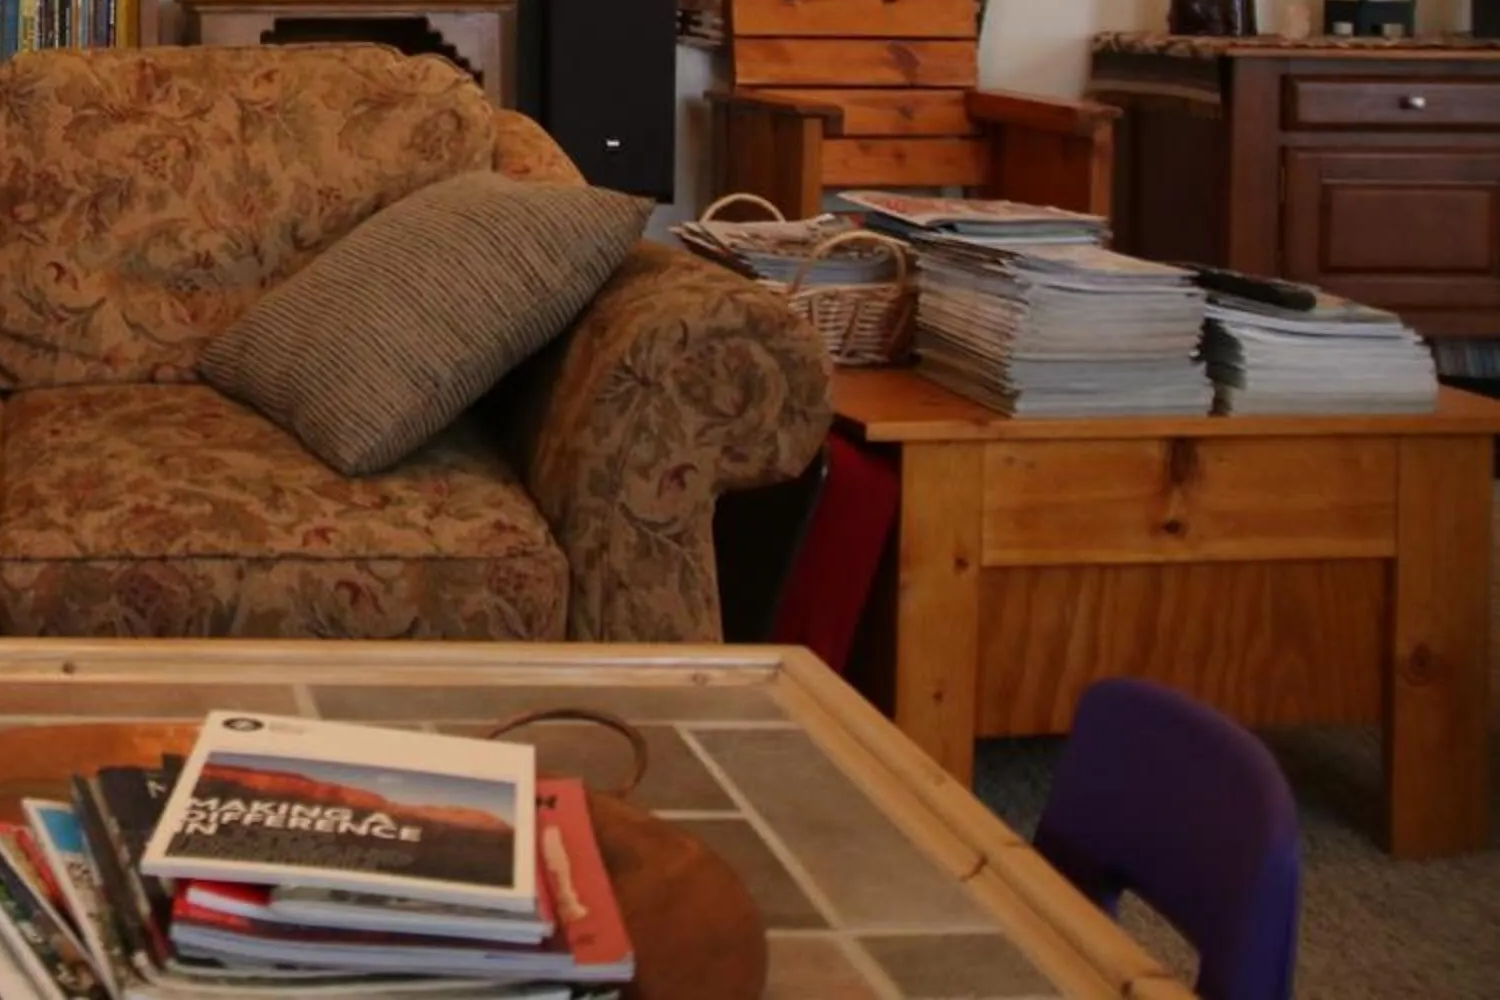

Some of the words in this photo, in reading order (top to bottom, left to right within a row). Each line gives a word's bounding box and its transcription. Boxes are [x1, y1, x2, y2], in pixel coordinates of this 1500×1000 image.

[182, 809, 422, 842] DIFFERENCE
[186, 798, 352, 821] MAKING
[364, 812, 397, 832] A
